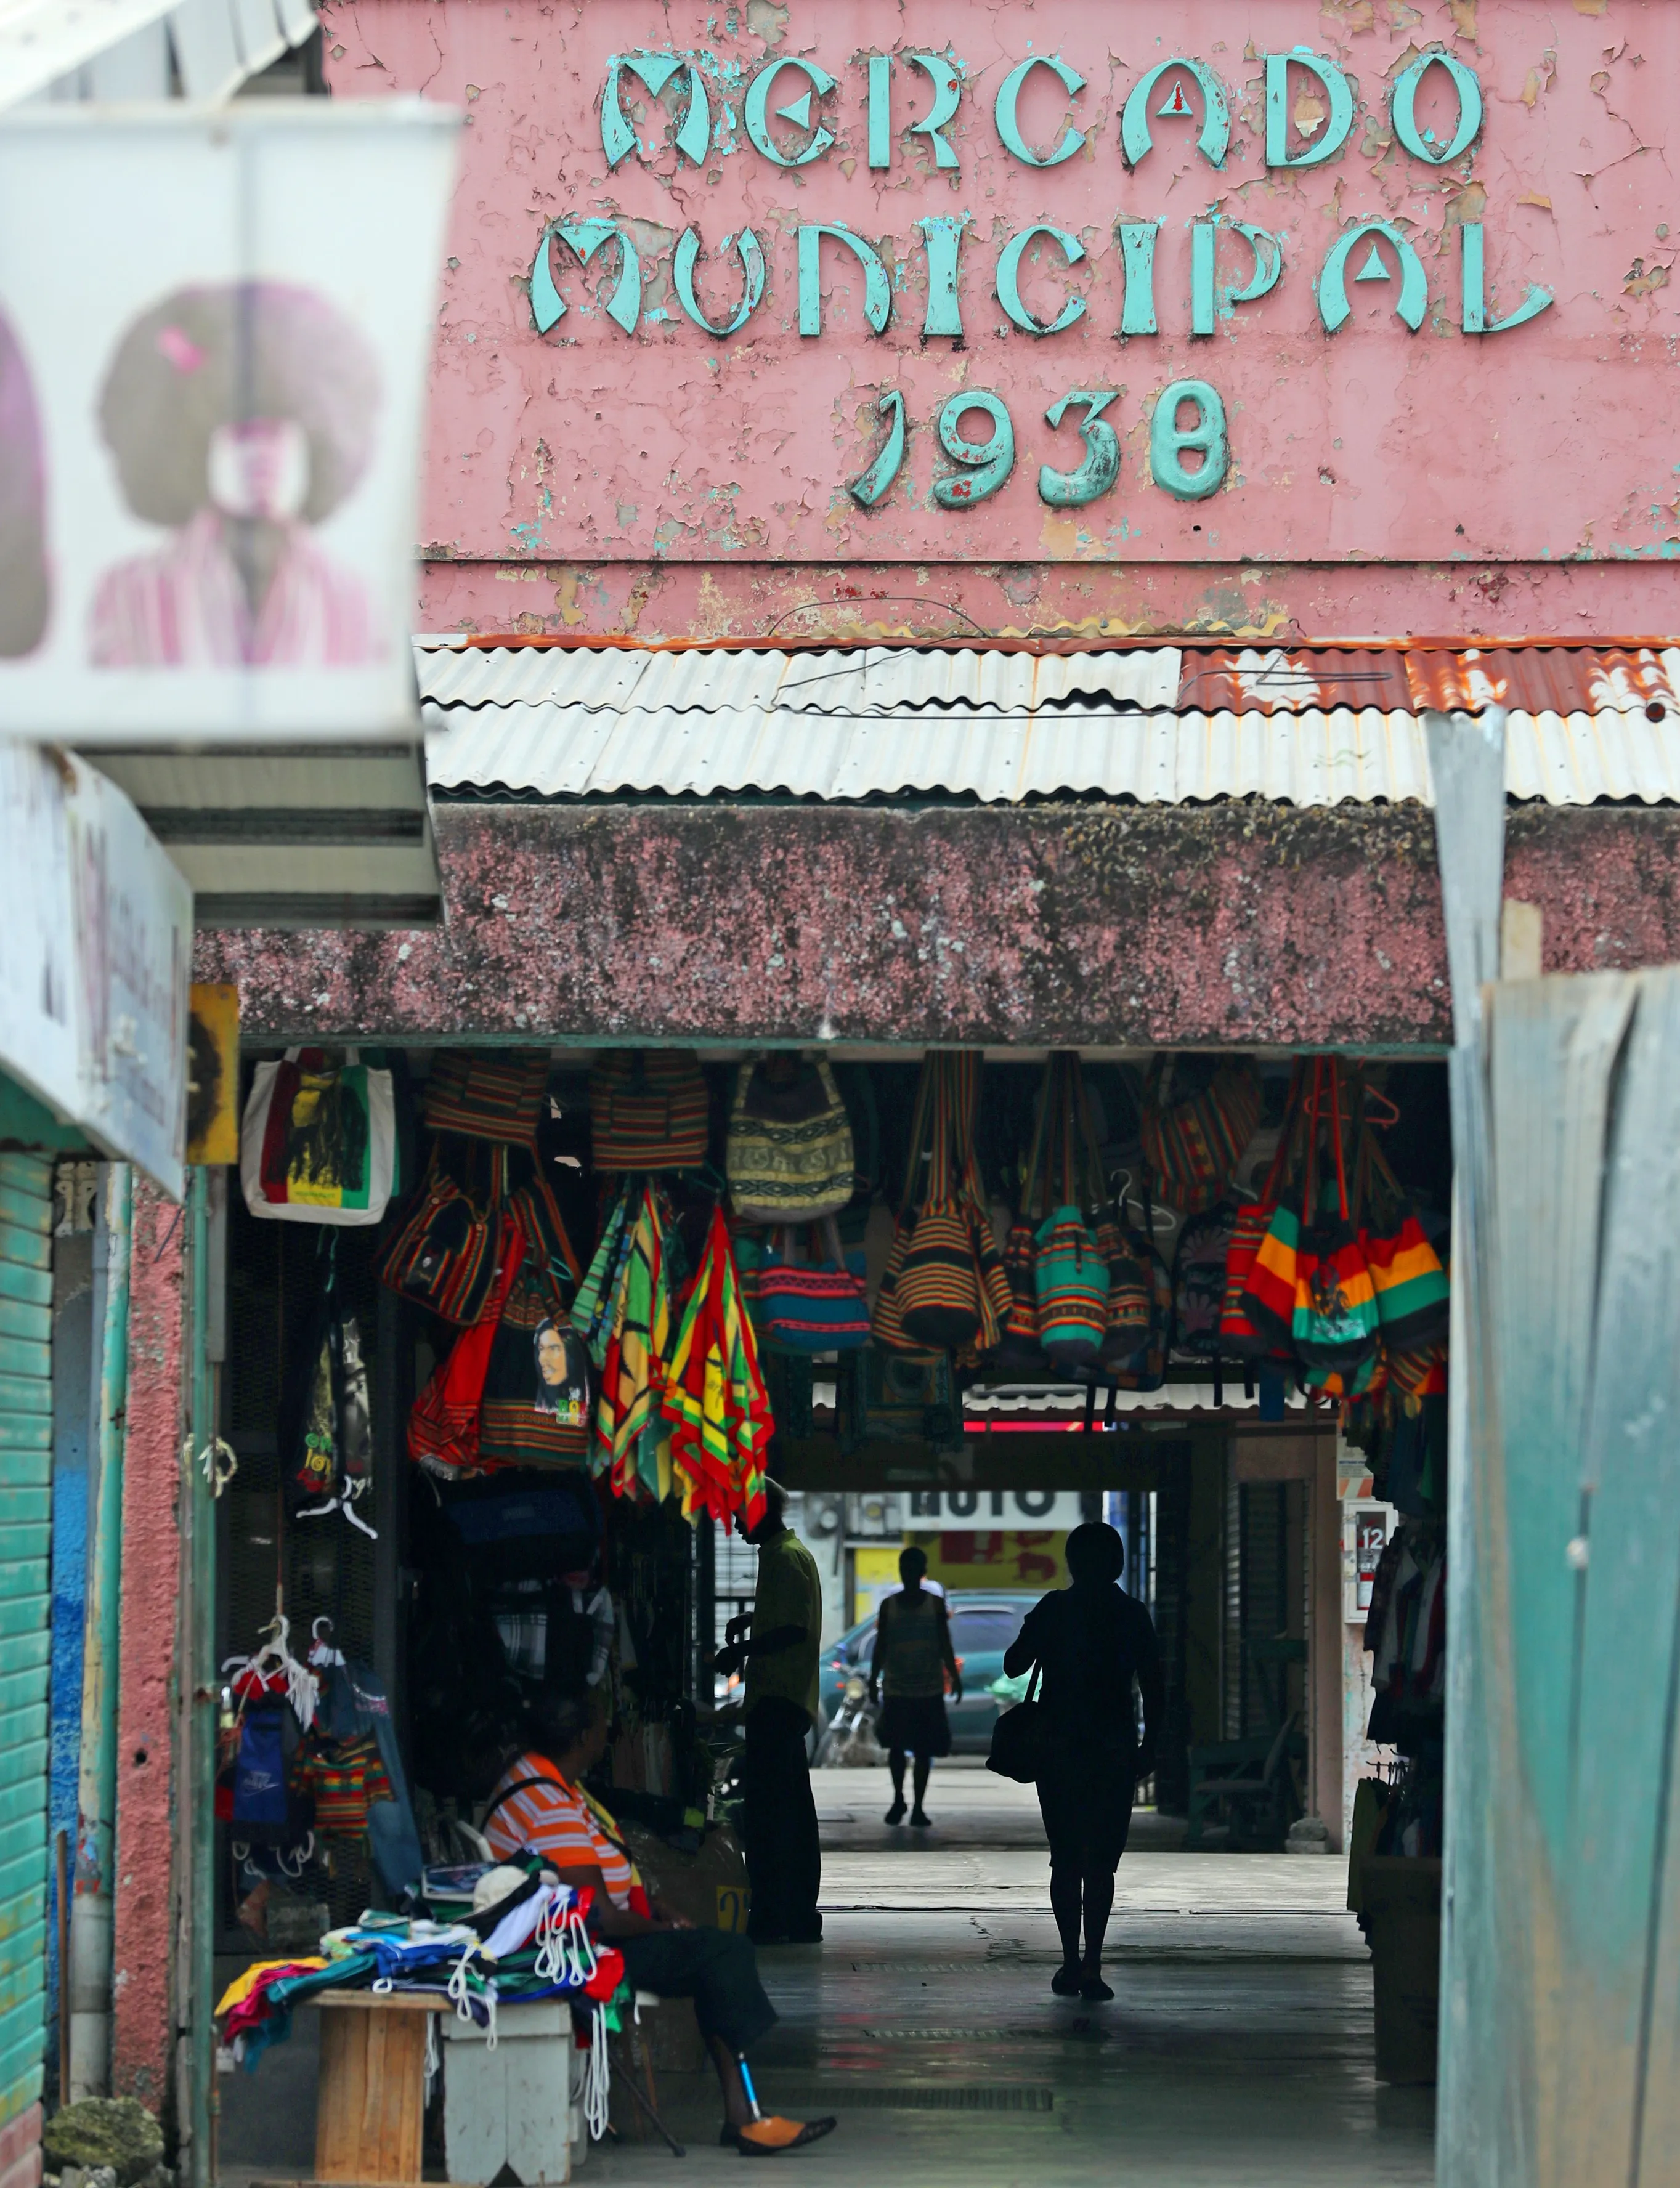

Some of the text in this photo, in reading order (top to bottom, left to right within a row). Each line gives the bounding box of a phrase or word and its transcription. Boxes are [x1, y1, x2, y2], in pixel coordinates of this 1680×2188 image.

[599, 53, 1483, 169] MERCADO
[530, 221, 1554, 337] MUNICIPAL
[850, 379, 1228, 508] 1938
[1361, 1527, 1384, 1550] 12
